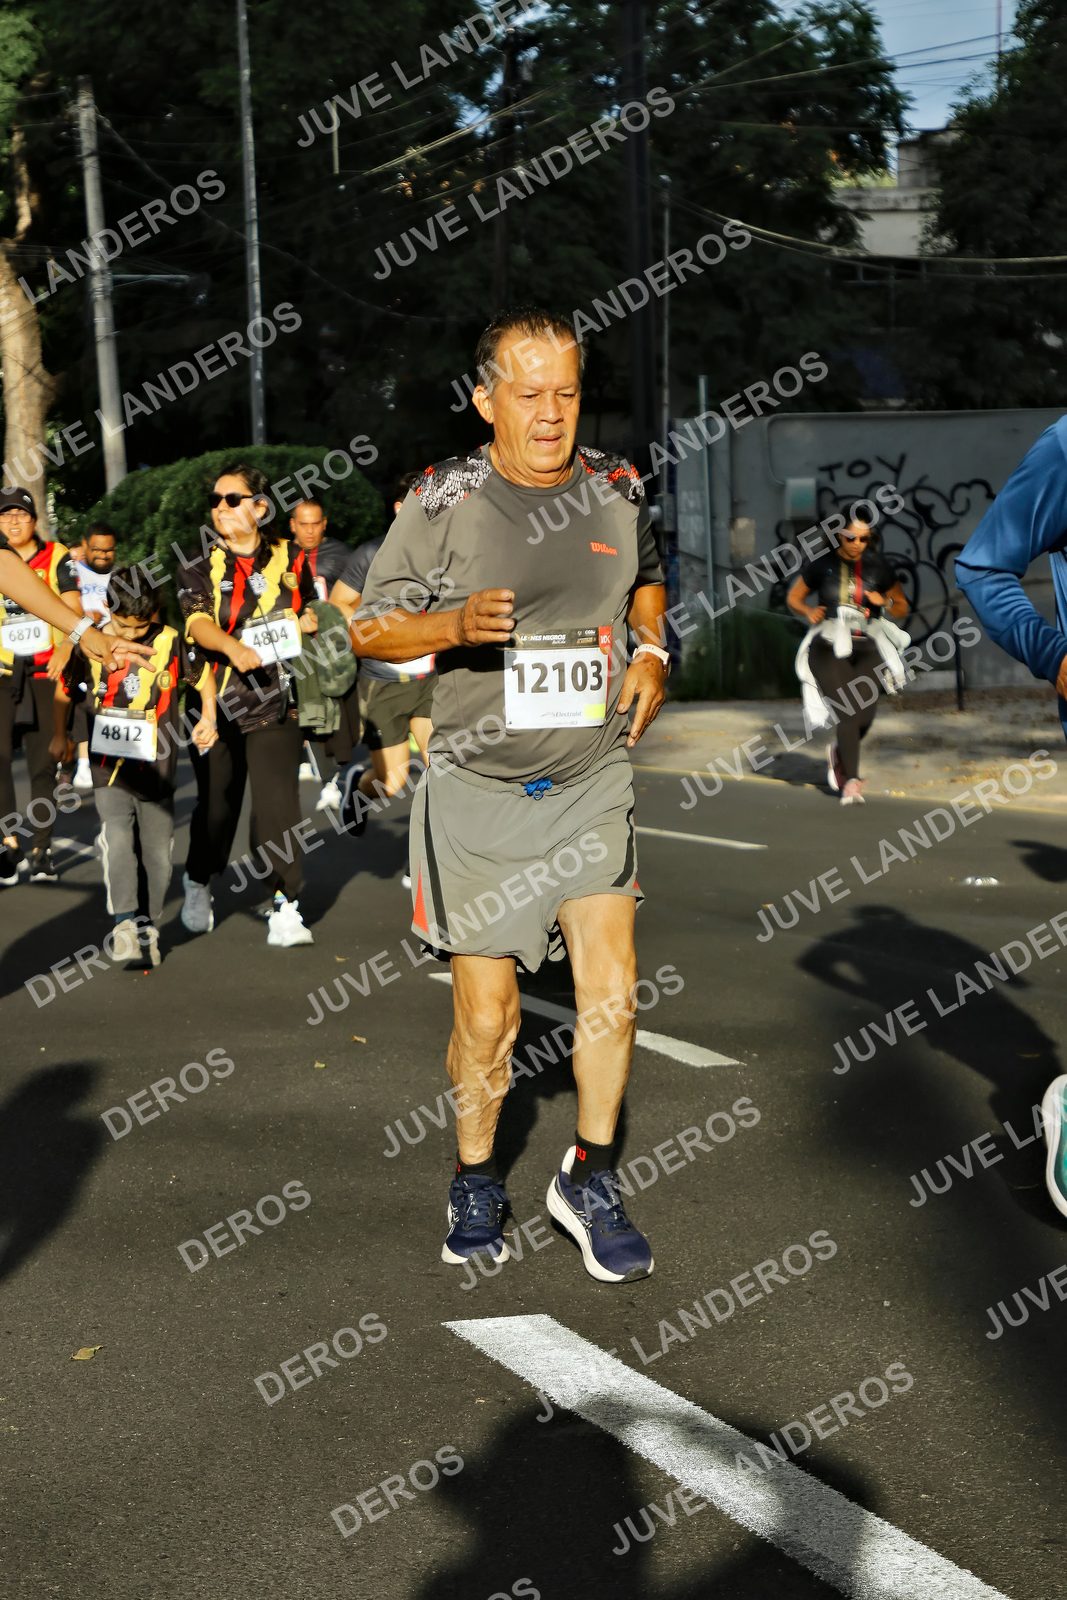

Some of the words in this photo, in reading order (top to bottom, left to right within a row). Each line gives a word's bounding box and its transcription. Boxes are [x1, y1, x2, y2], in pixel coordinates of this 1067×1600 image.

[817, 452, 907, 488] TOY
[590, 541, 617, 556] Wilson
[9, 626, 41, 642] 6870
[253, 625, 288, 647] 4804
[511, 660, 603, 693] 12103
[101, 724, 142, 741] 4812
